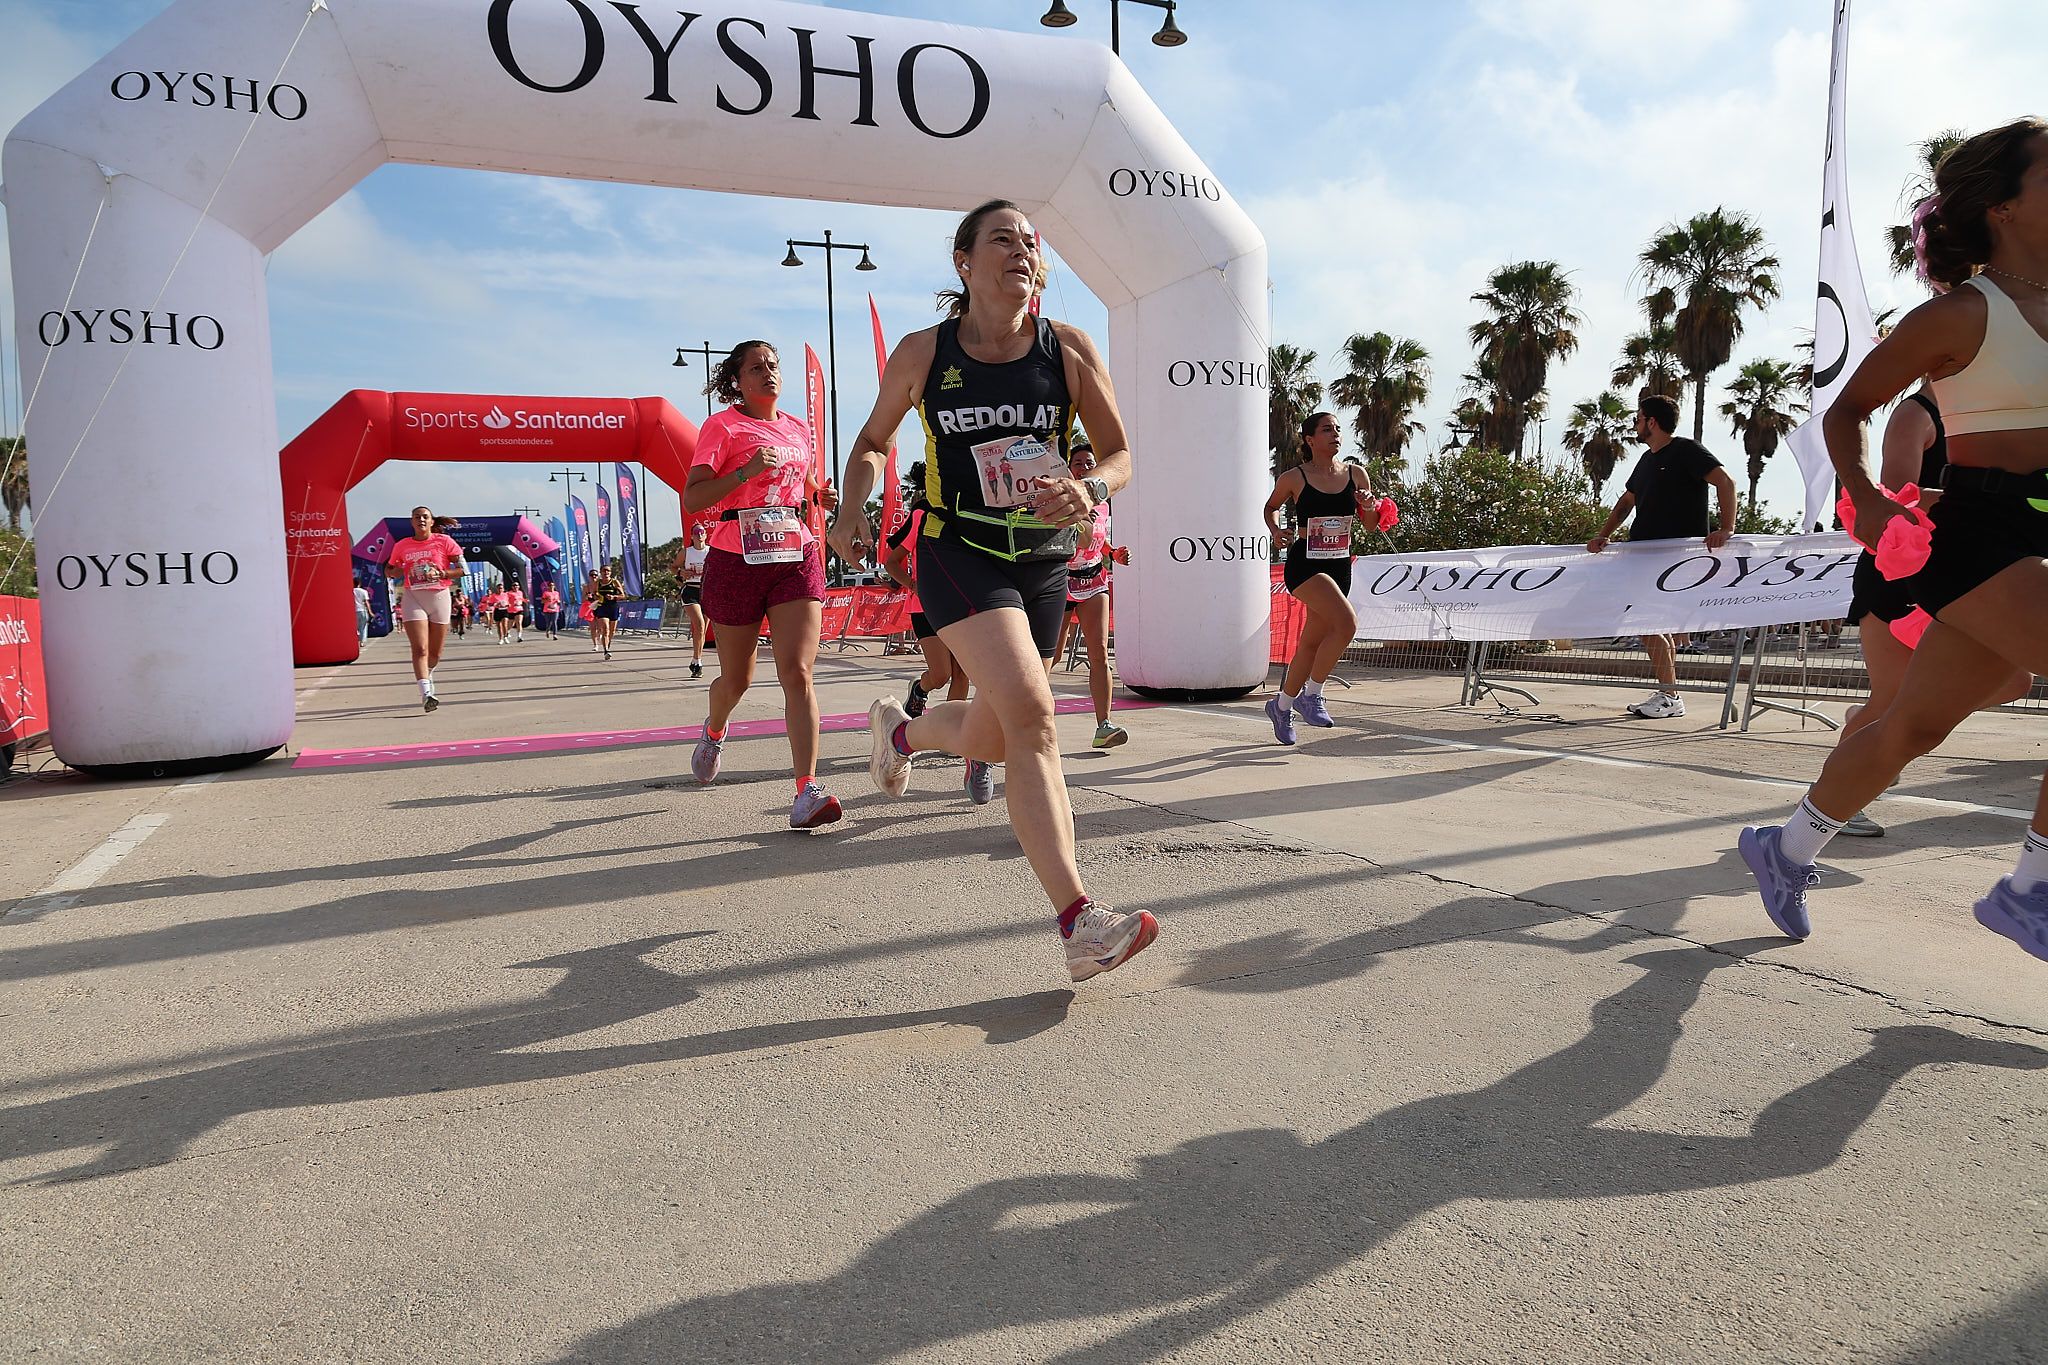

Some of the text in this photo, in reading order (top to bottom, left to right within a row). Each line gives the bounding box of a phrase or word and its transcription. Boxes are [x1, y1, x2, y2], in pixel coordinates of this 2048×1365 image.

[487, 0, 990, 139] OYSHO
[111, 71, 308, 120] OYSHO
[1109, 168, 1221, 202] OYSHO
[38, 308, 225, 350] OYSHO
[1168, 360, 1268, 389] OYSHO
[405, 407, 626, 432] Sports Santander
[480, 438, 555, 446] sportssantander.es
[1016, 474, 1050, 494] 01
[290, 511, 327, 524] Sports
[288, 528, 341, 538] Santander
[762, 531, 786, 542] 016
[1169, 536, 1268, 562] OYSHO
[57, 551, 239, 591] OYSHO
[1371, 564, 1567, 596] OYSHO
[1656, 553, 1858, 593] OYSH
[1394, 602, 1479, 613] WWW.OYSHO.COM
[1700, 589, 1839, 607] WWW.OYSHO.COM
[1810, 821, 1828, 834] alo
